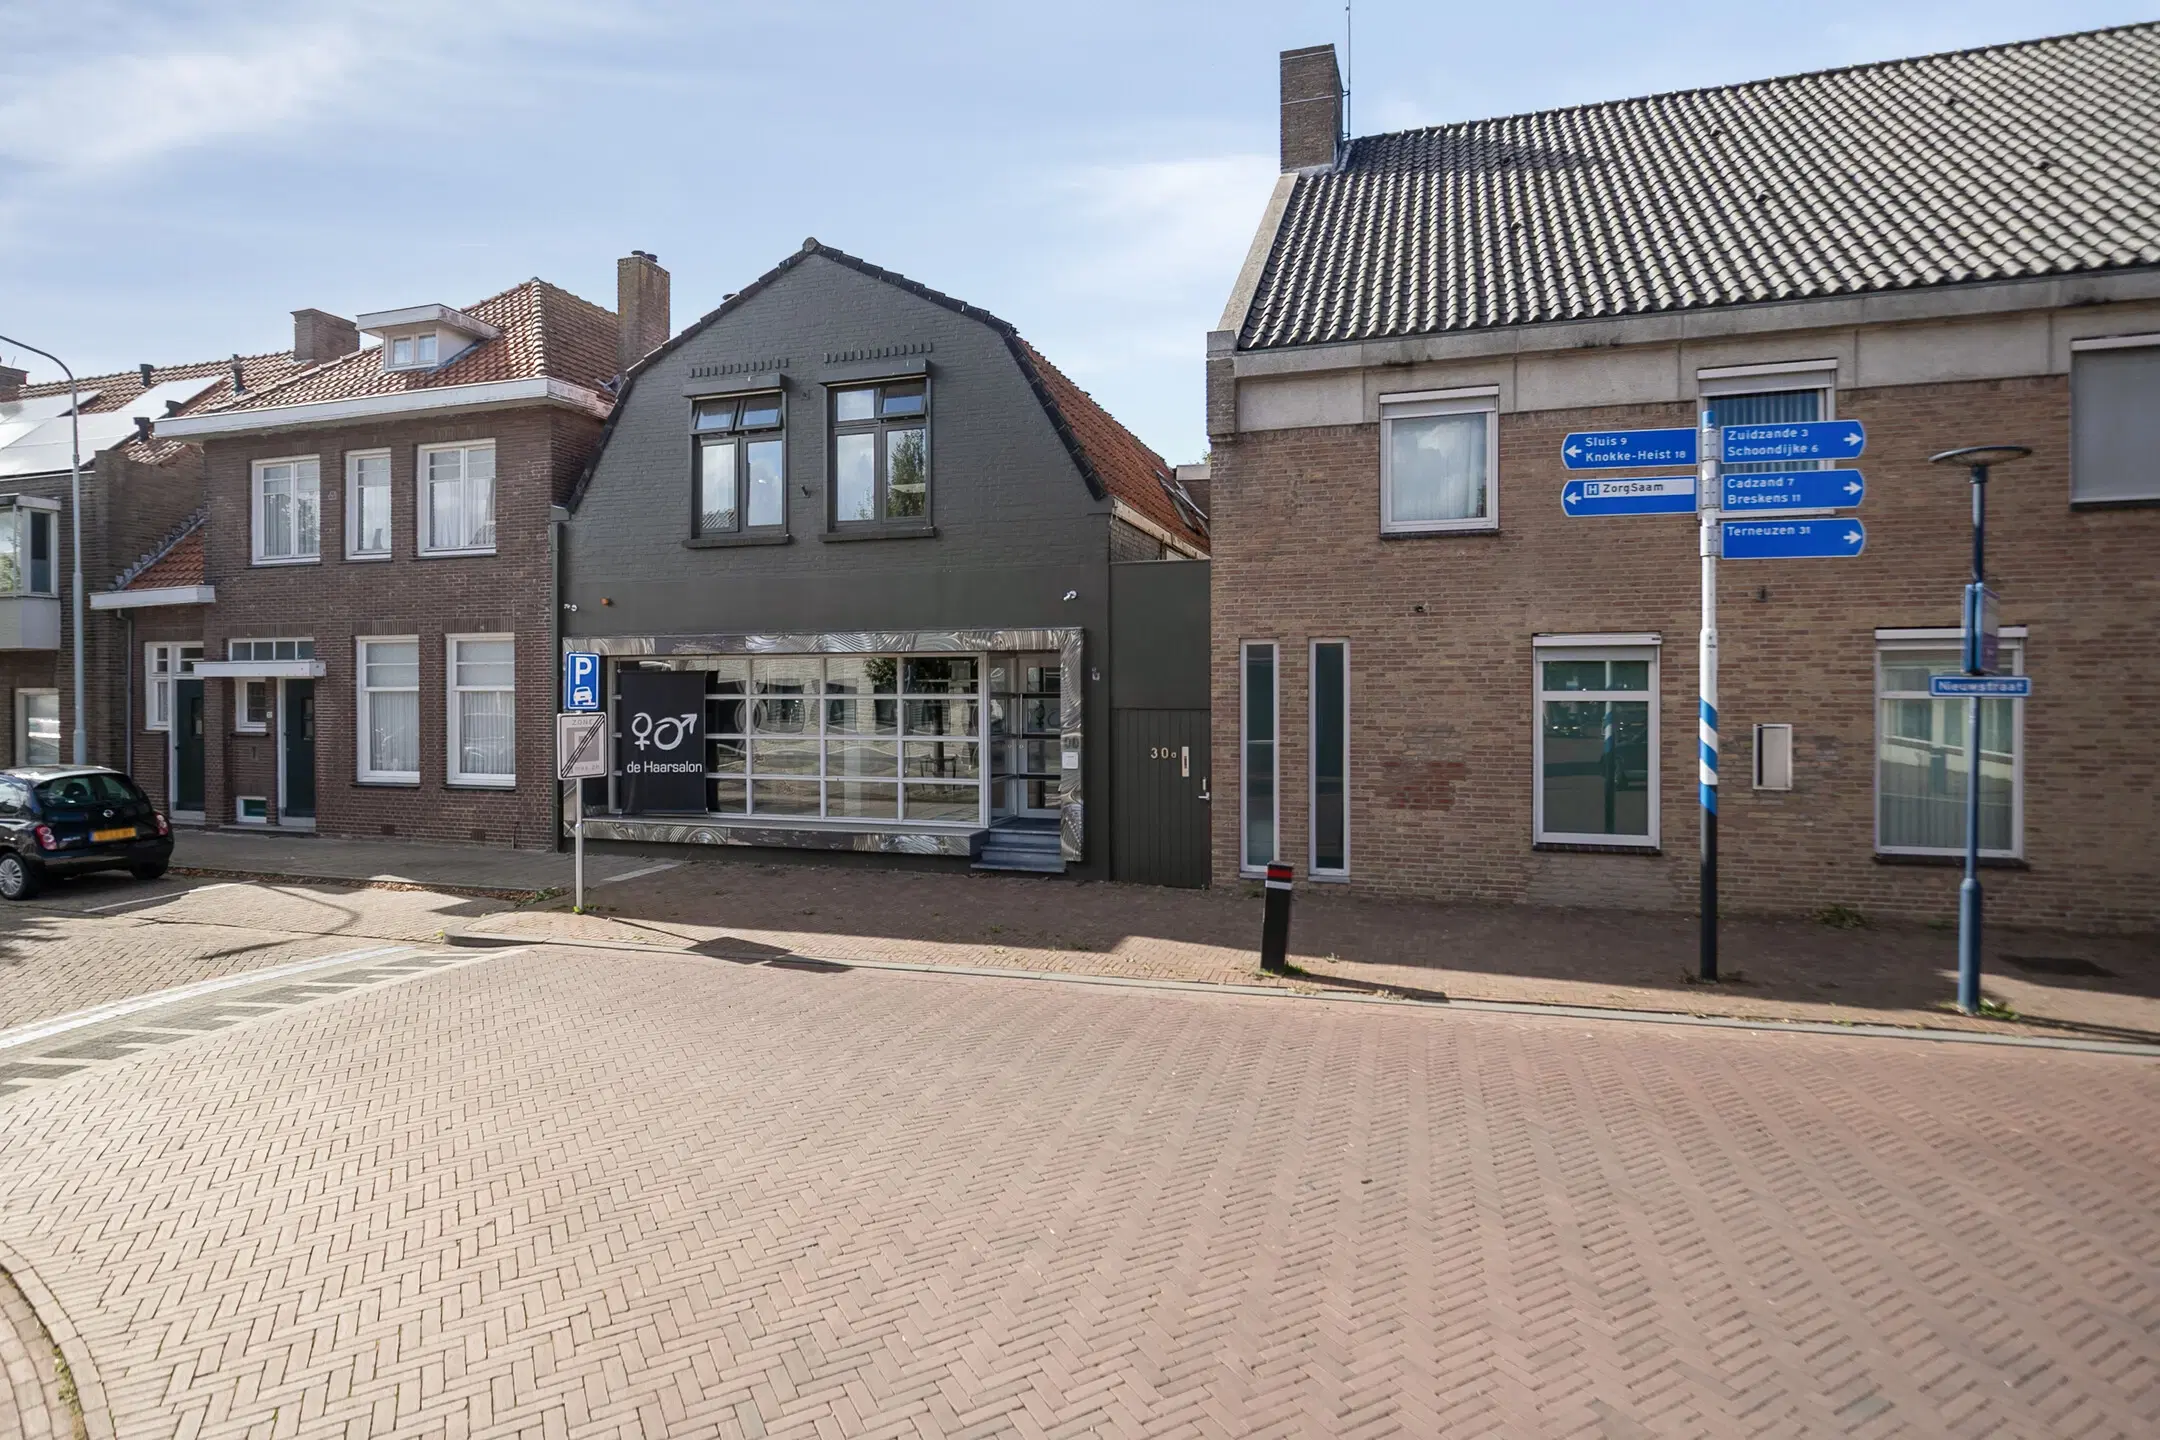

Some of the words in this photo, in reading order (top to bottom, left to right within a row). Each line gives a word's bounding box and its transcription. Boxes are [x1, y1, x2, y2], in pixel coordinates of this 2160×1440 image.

[1728, 429, 1798, 441] Zuidzande
[1801, 429, 1809, 437] 3
[1585, 437, 1617, 447] Sluis
[1620, 437, 1628, 446] 9
[1585, 450, 1672, 462] Knokke-Heist
[1675, 450, 1686, 459] 18
[1728, 444, 1807, 456] Schoondijke
[1811, 444, 1819, 453] 6
[1603, 483, 1664, 495] ZorgSaam
[1727, 477, 1784, 489] Cadzand
[1786, 478, 1795, 487] 7
[1727, 493, 1789, 504] Breskens
[1792, 494, 1801, 502] 11
[1727, 526, 1796, 536] Terneuzen
[1799, 526, 1811, 535] 31
[575, 657, 592, 684] P
[1938, 681, 2024, 691] Nieuwstraat
[626, 760, 641, 773] de
[644, 760, 703, 773] Haarsalon
